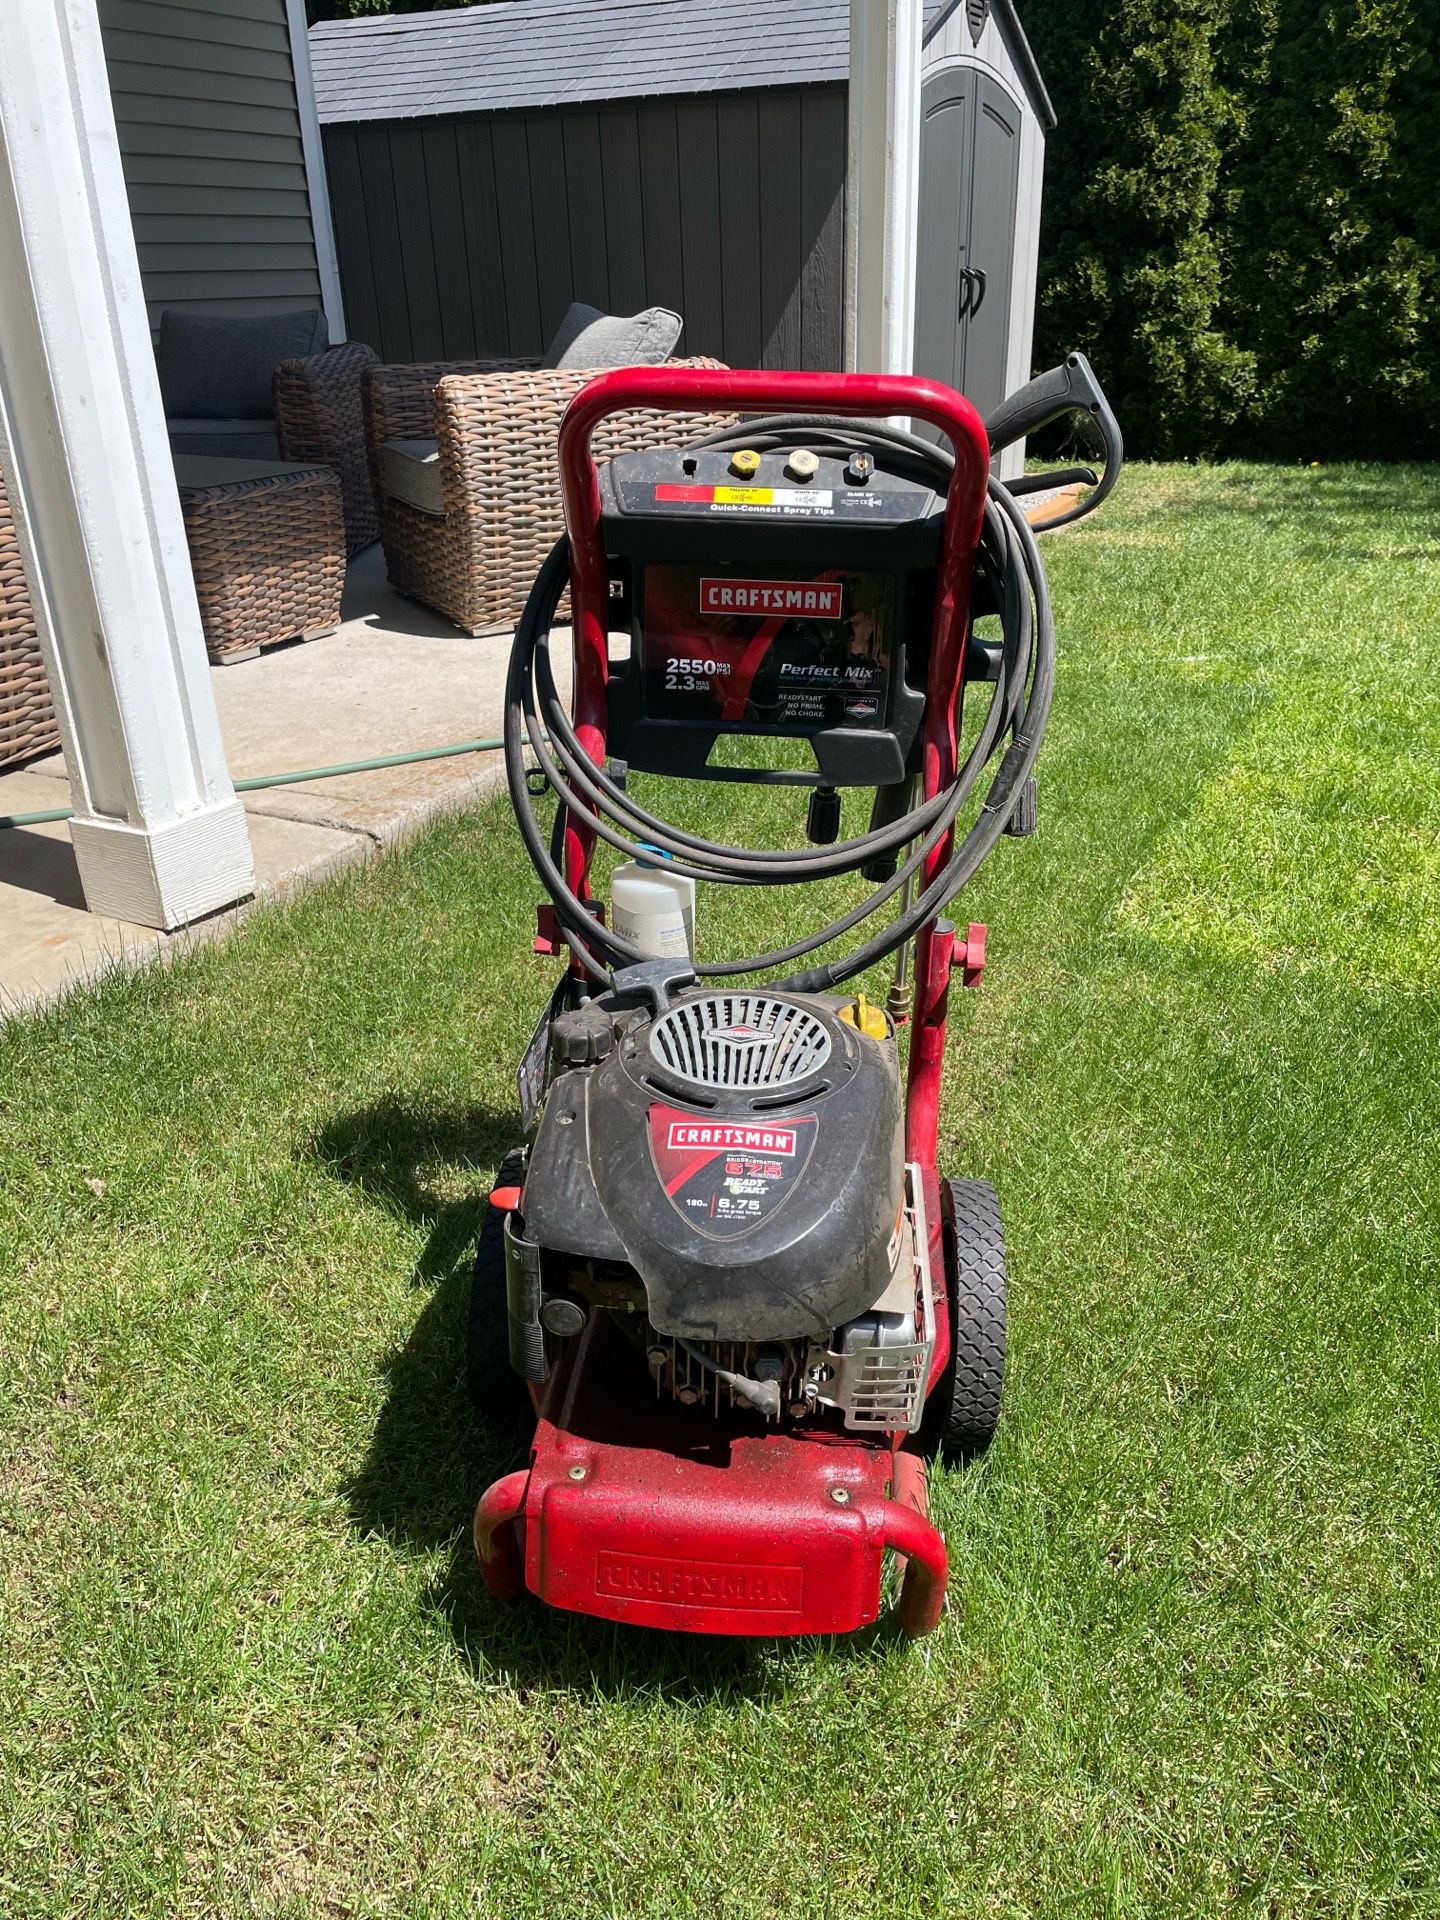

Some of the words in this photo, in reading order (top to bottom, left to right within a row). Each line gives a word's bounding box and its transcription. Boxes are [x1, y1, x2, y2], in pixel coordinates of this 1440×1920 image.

[710, 504, 781, 513] Quick-Connect
[784, 507, 811, 515] Spray
[814, 507, 835, 515] Tips
[709, 587, 832, 610] CRAFTSMAN
[666, 658, 716, 675] 2550
[780, 663, 840, 677] Perfect
[845, 666, 874, 678] Mix
[665, 674, 695, 690] 2.3
[676, 1129, 788, 1149] CRAFTSMAN
[725, 1162, 782, 1179] 675
[723, 1176, 766, 1187] READY
[718, 1198, 760, 1210] 6.75
[606, 1563, 789, 1602] CRAFTSMAN
